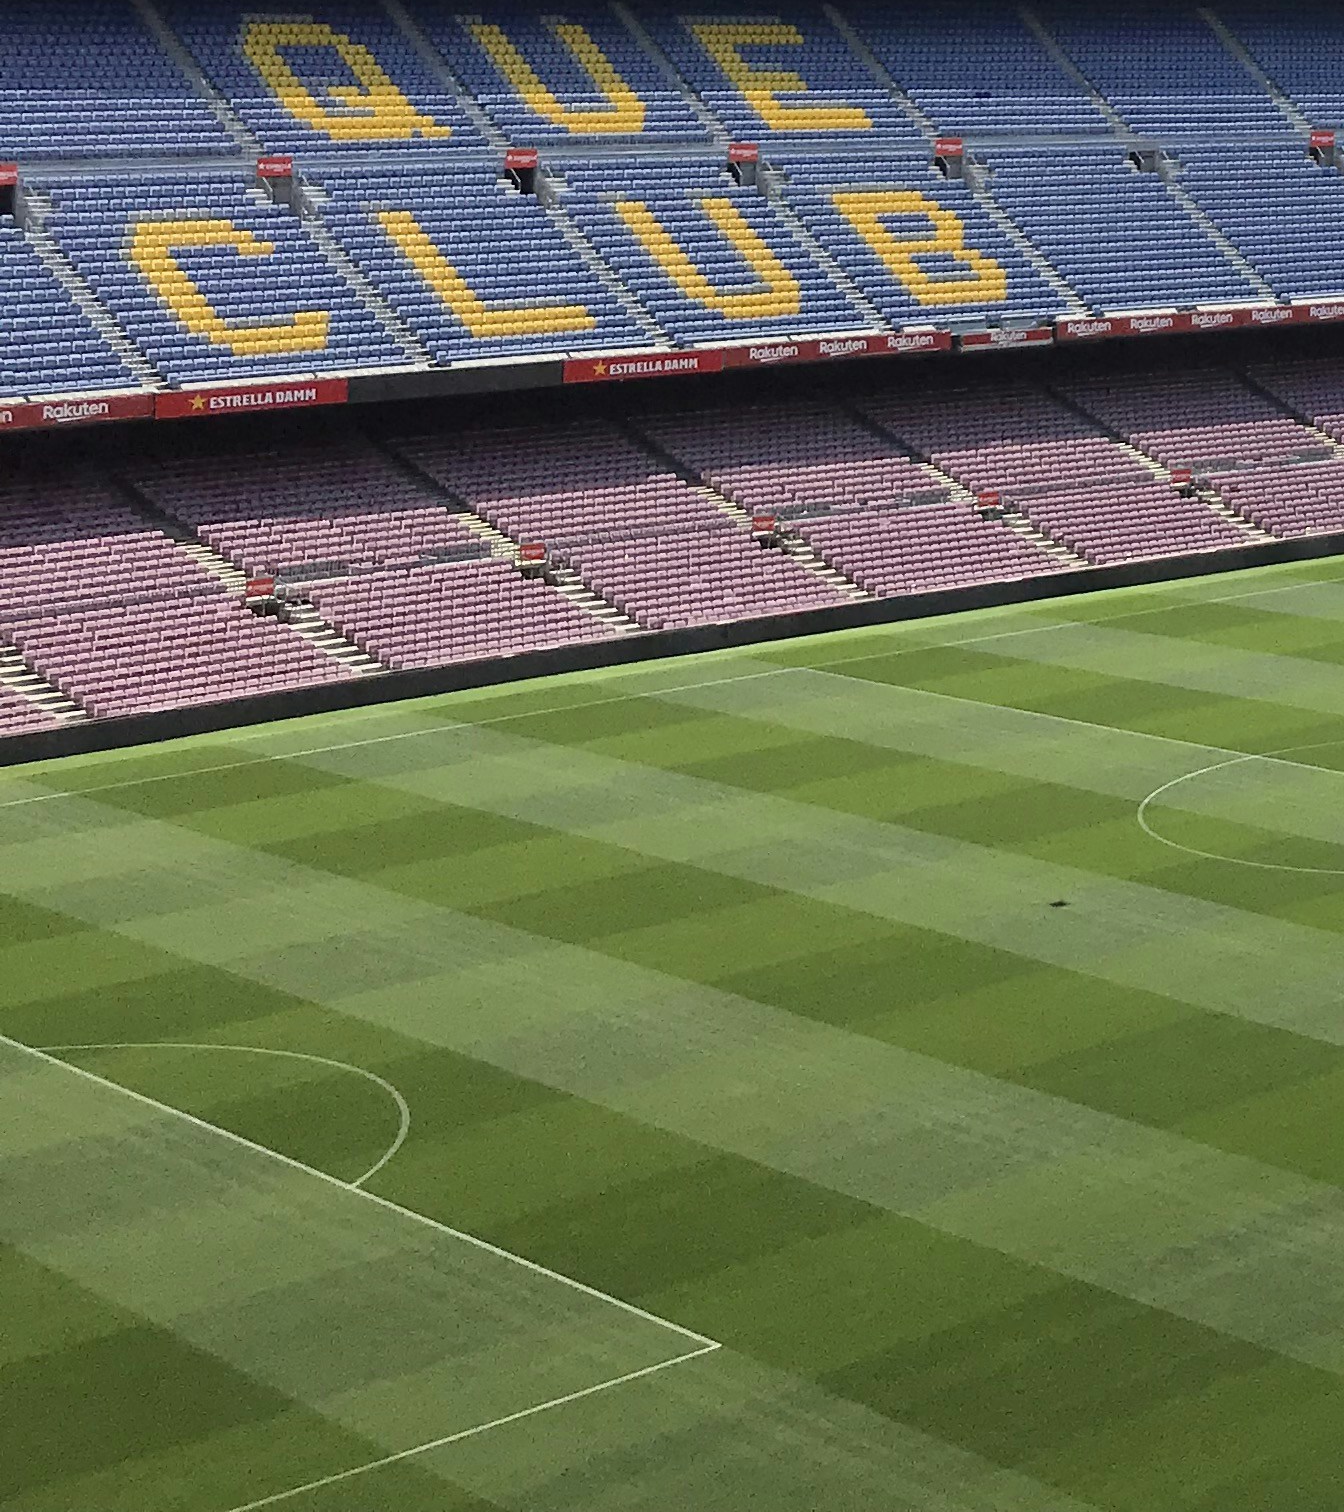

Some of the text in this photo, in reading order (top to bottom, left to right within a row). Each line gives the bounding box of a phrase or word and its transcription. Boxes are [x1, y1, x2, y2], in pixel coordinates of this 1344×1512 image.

[245, 22, 872, 140] QUE
[131, 192, 1008, 355] CLUB
[1192, 312, 1233, 326] Rakuten
[1251, 308, 1293, 321] Rakuten
[1067, 320, 1111, 334] Rakuten
[1130, 316, 1173, 330] Rakuten
[819, 339, 867, 354] Rakuten
[887, 334, 934, 348] Rakuten
[749, 345, 798, 360] Rakuten
[609, 357, 699, 374] ESTRELLA DAMM
[209, 387, 317, 409] ESTRELLA DAMM
[43, 402, 109, 421] Rakuten
